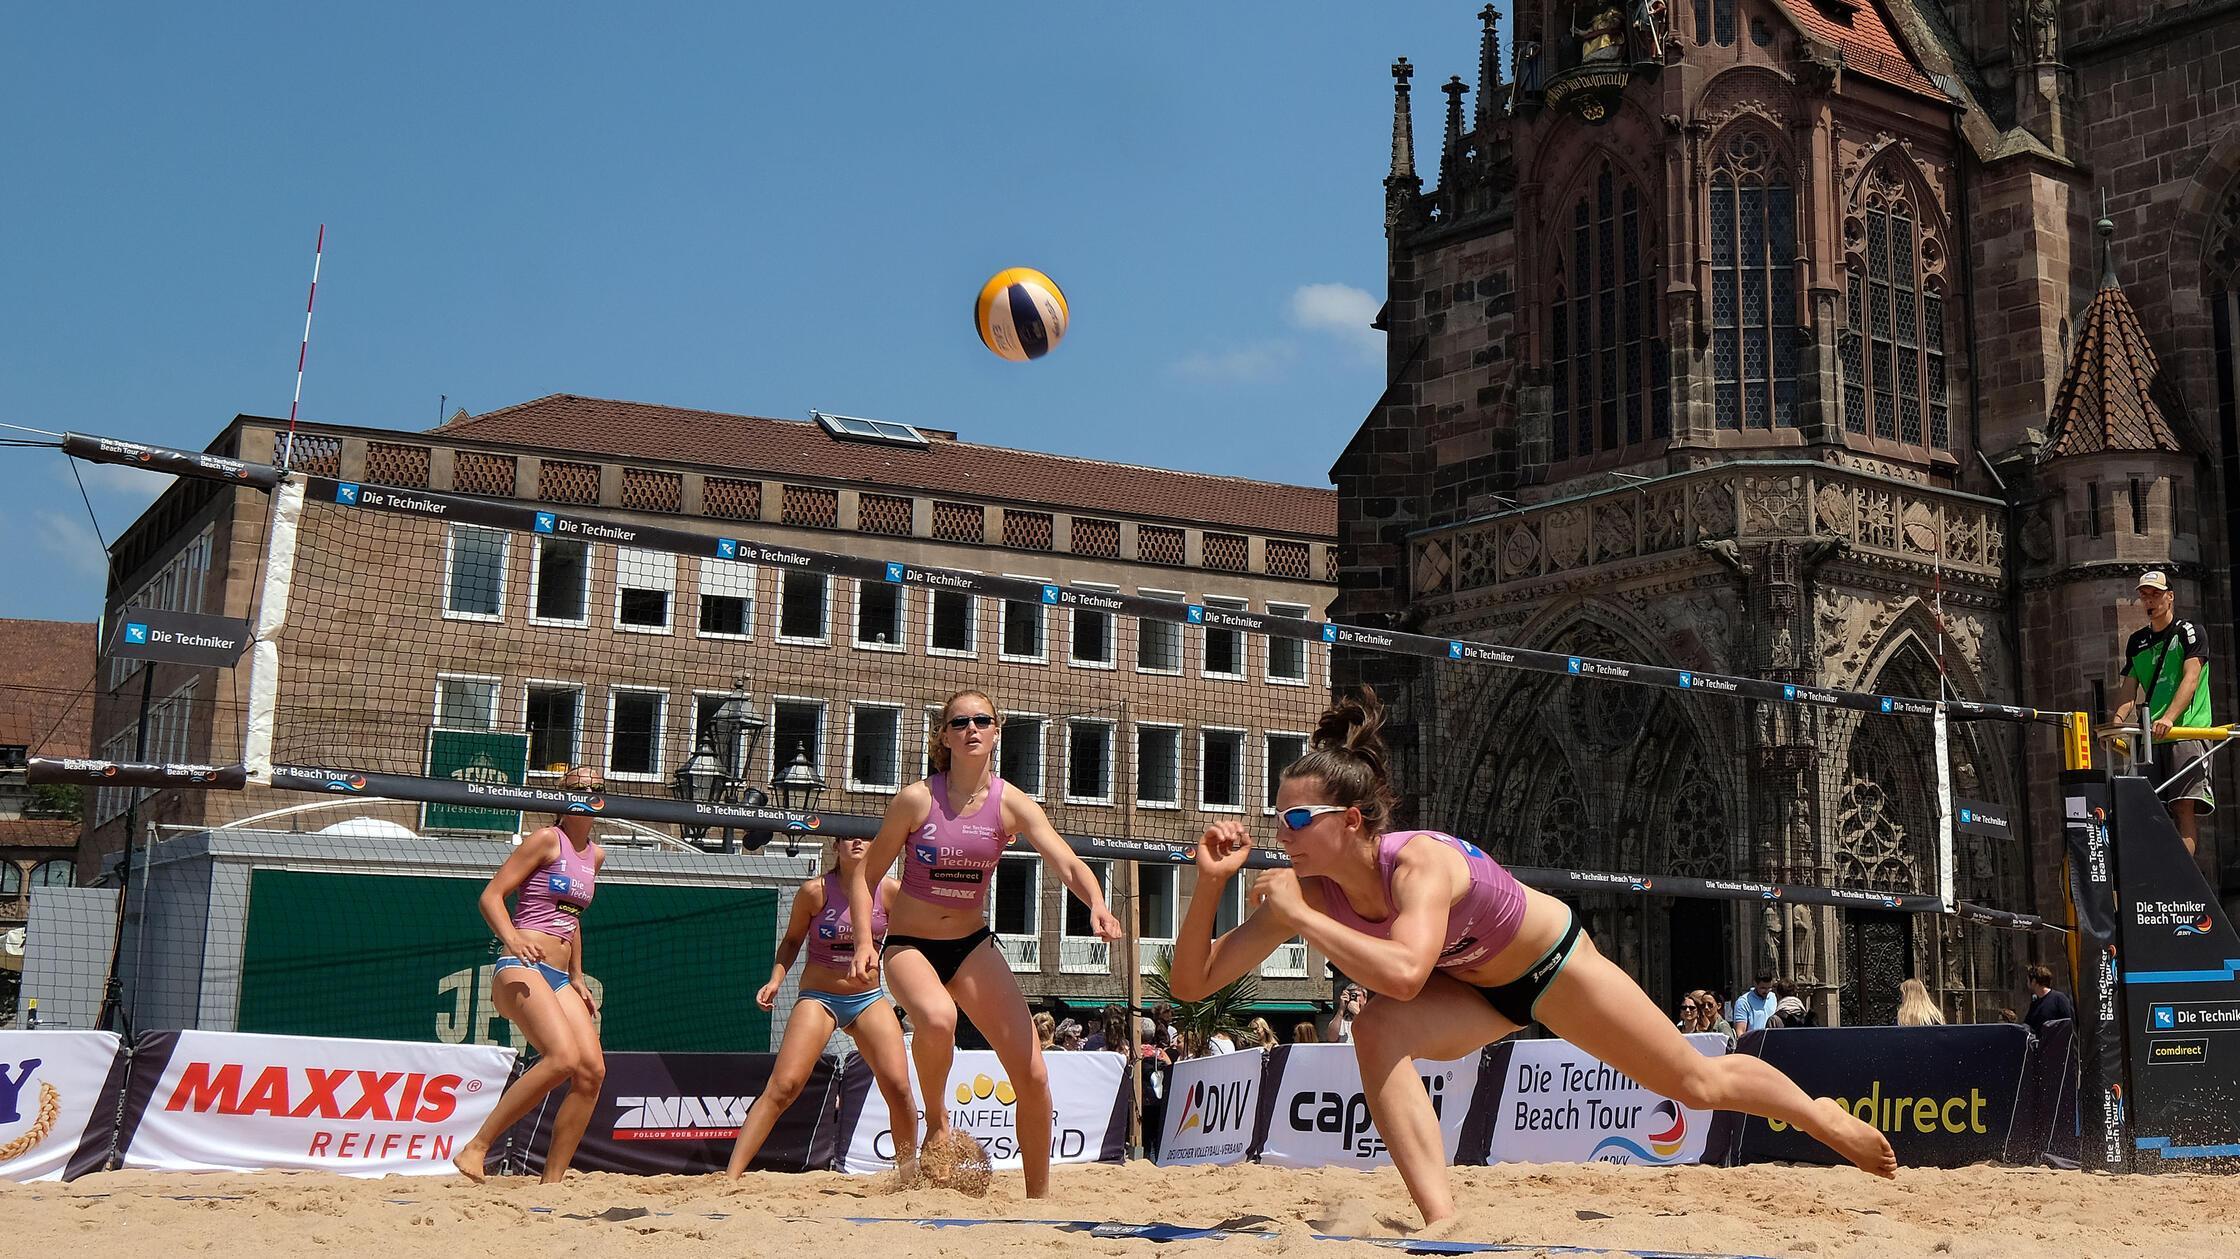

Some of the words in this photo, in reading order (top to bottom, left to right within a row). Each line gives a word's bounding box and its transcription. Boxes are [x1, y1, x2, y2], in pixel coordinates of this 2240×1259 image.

[100, 444, 122, 453] Beach
[123, 447, 138, 456] Tour
[200, 461, 221, 470] Beach
[222, 464, 237, 472] Tour
[214, 458, 245, 468] Techniker
[362, 491, 384, 504] Die
[388, 494, 446, 514] Techniker
[558, 520, 578, 532] Die
[581, 523, 636, 541] Techniker
[739, 546, 758, 558] Die
[760, 549, 810, 566] Techniker
[906, 570, 923, 581] Die
[926, 572, 972, 589] Techniker
[1061, 592, 1076, 603] Die
[1078, 594, 1123, 609] Techniker
[1205, 612, 1220, 622] Die
[1222, 614, 1262, 629] Techniker
[152, 630, 172, 642] Die
[176, 633, 235, 649] Techniker
[1339, 630, 1352, 640] Die
[1354, 632, 1393, 646] Techniker
[1464, 647, 1477, 658] Die
[1479, 649, 1515, 663] Techniker
[1582, 663, 1594, 672] Die
[1596, 664, 1630, 677] Techniker
[1692, 678, 1704, 686] Die
[1705, 679, 1737, 691] Techniker
[1797, 690, 1808, 699] Die
[1808, 692, 1838, 704] Techniker
[1894, 702, 1904, 711] Die
[1905, 704, 1932, 714] Techniker
[291, 768, 322, 779] Beach
[324, 770, 348, 780] Tour
[468, 784, 484, 794] Die
[486, 786, 534, 798] Techniker
[536, 789, 564, 802] Beach
[566, 792, 588, 802] Tour
[696, 804, 712, 814] Die
[714, 805, 756, 818] Techniker
[758, 808, 784, 820] Beach
[785, 810, 805, 822] Tour
[1972, 814, 1981, 822] Die
[1982, 814, 2008, 827] Techniker
[922, 824, 937, 840] 2
[2087, 812, 2096, 862] Technikr
[940, 846, 964, 856] Die
[1092, 838, 1105, 847] Die
[1106, 839, 1141, 850] Techniker
[1144, 842, 1166, 852] Beach
[1166, 843, 1183, 852] Tour
[941, 858, 996, 868] Technik
[1265, 852, 1277, 860] Die
[560, 860, 566, 872] 1
[2091, 864, 2100, 882] Die
[2097, 850, 2106, 882] Beach
[572, 879, 584, 890] Die
[1570, 872, 1580, 880] Die
[1581, 872, 1608, 882] Techniker
[1610, 874, 1628, 884] Beach
[1628, 876, 1642, 884] Tour
[1706, 880, 1716, 889] Die
[1716, 882, 1742, 890] Techniker
[1743, 883, 1760, 892] Beach
[825, 908, 836, 920] 2
[2136, 902, 2154, 912] Die
[2156, 901, 2206, 912] Techniker
[2138, 914, 2168, 924] Beach
[2170, 914, 2194, 924] Tour
[2099, 950, 2108, 1001] Techniker
[2178, 1011, 2196, 1022] Die
[2199, 1009, 2240, 1022] Technik
[2156, 1045, 2202, 1056] comdirect
[1518, 1064, 1552, 1093] Die
[1560, 1061, 1646, 1092] Techn
[164, 1062, 464, 1124] MAXXIS
[1202, 1080, 1252, 1134] DVV
[1515, 1099, 1578, 1130] Beach
[1587, 1100, 1642, 1130] Tour
[2104, 1088, 2113, 1142] Techniker
[309, 1132, 454, 1161] REIFEN
[2113, 1129, 2121, 1162] Beach
[1167, 1148, 1194, 1160] DEUTSCHER
